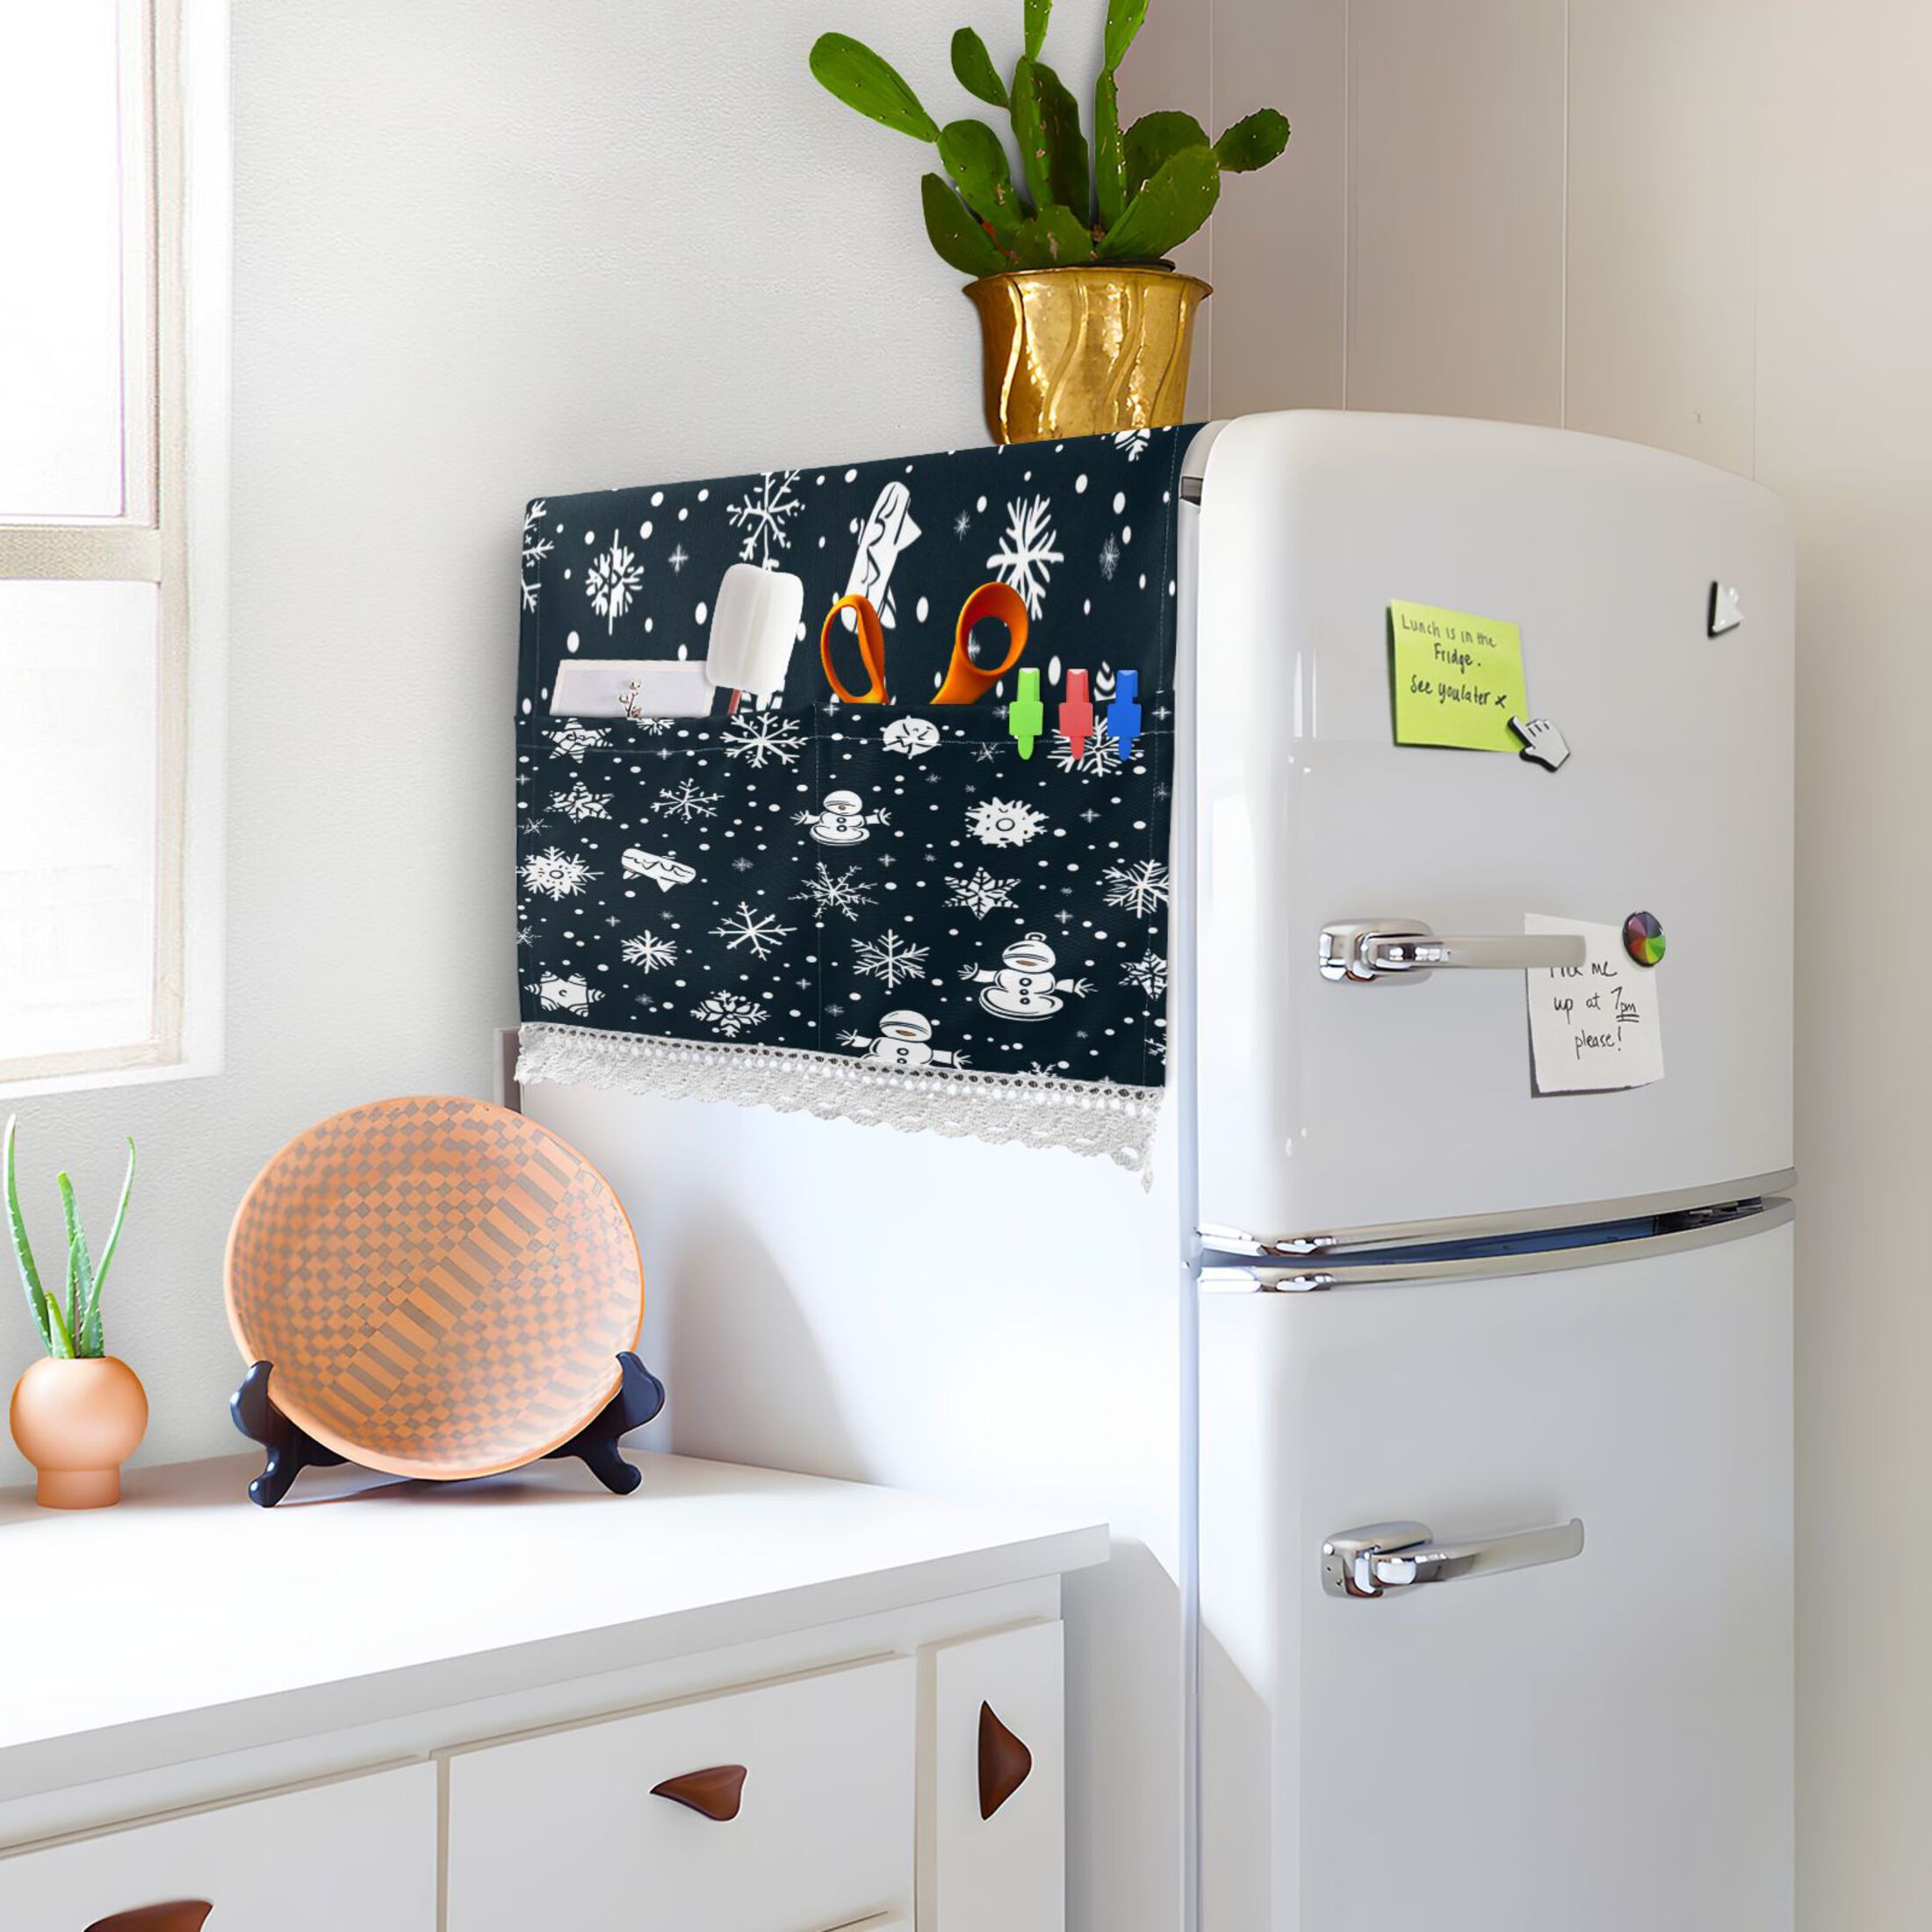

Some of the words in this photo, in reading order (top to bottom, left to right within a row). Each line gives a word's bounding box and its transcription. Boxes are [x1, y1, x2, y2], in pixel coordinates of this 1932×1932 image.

[1402, 614, 1441, 638] Lunch
[1445, 627, 1455, 640] is
[1460, 631, 1473, 643] in
[1410, 674, 1433, 695] See
[1591, 961, 1618, 977] me
[1554, 997, 1574, 1025] up
[1586, 991, 1601, 1010] at
[1611, 986, 1638, 1021] 7pm
[1575, 1027, 1621, 1060] please!
